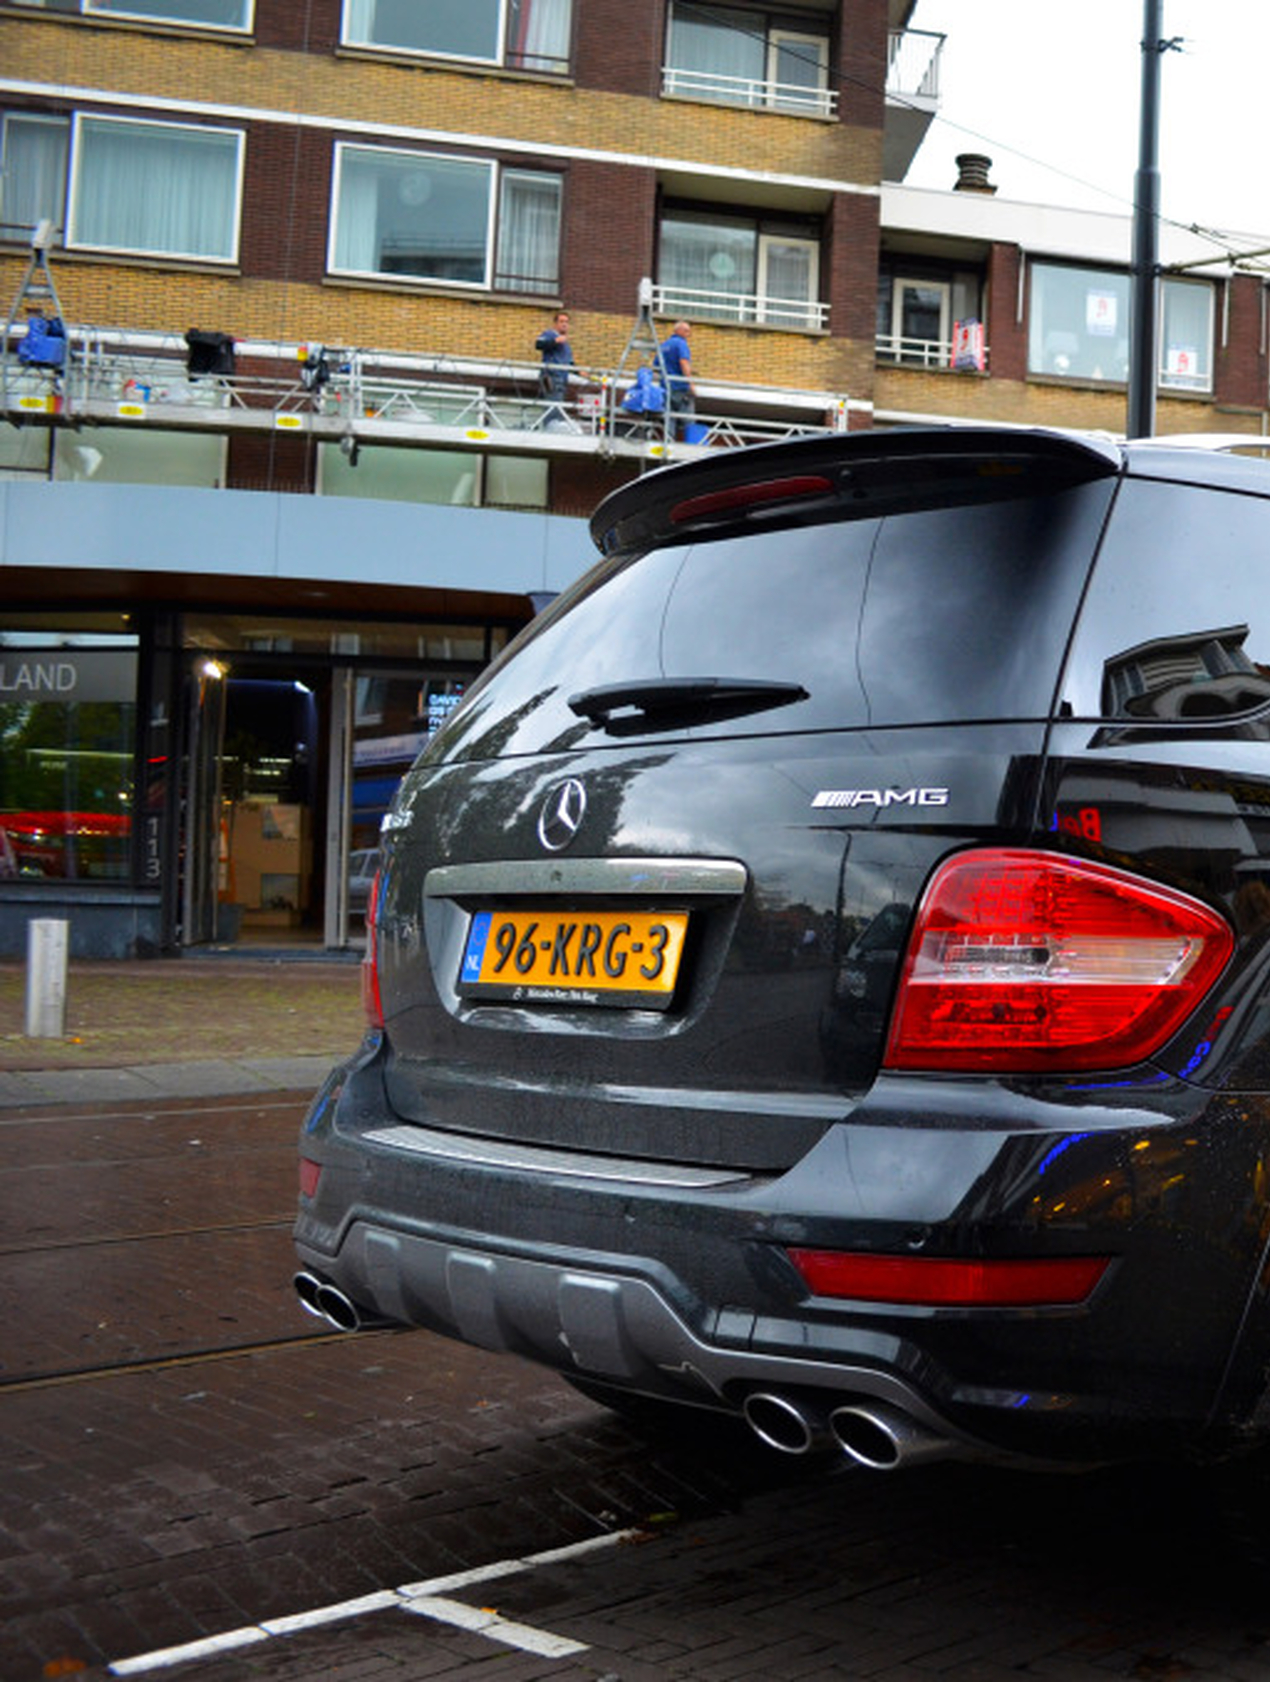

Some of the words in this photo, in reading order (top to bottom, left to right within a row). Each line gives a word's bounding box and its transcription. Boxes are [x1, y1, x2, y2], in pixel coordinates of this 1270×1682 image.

[850, 788, 949, 807] AMG
[493, 921, 669, 980] 96-KRG-3
[465, 955, 479, 971] NL
